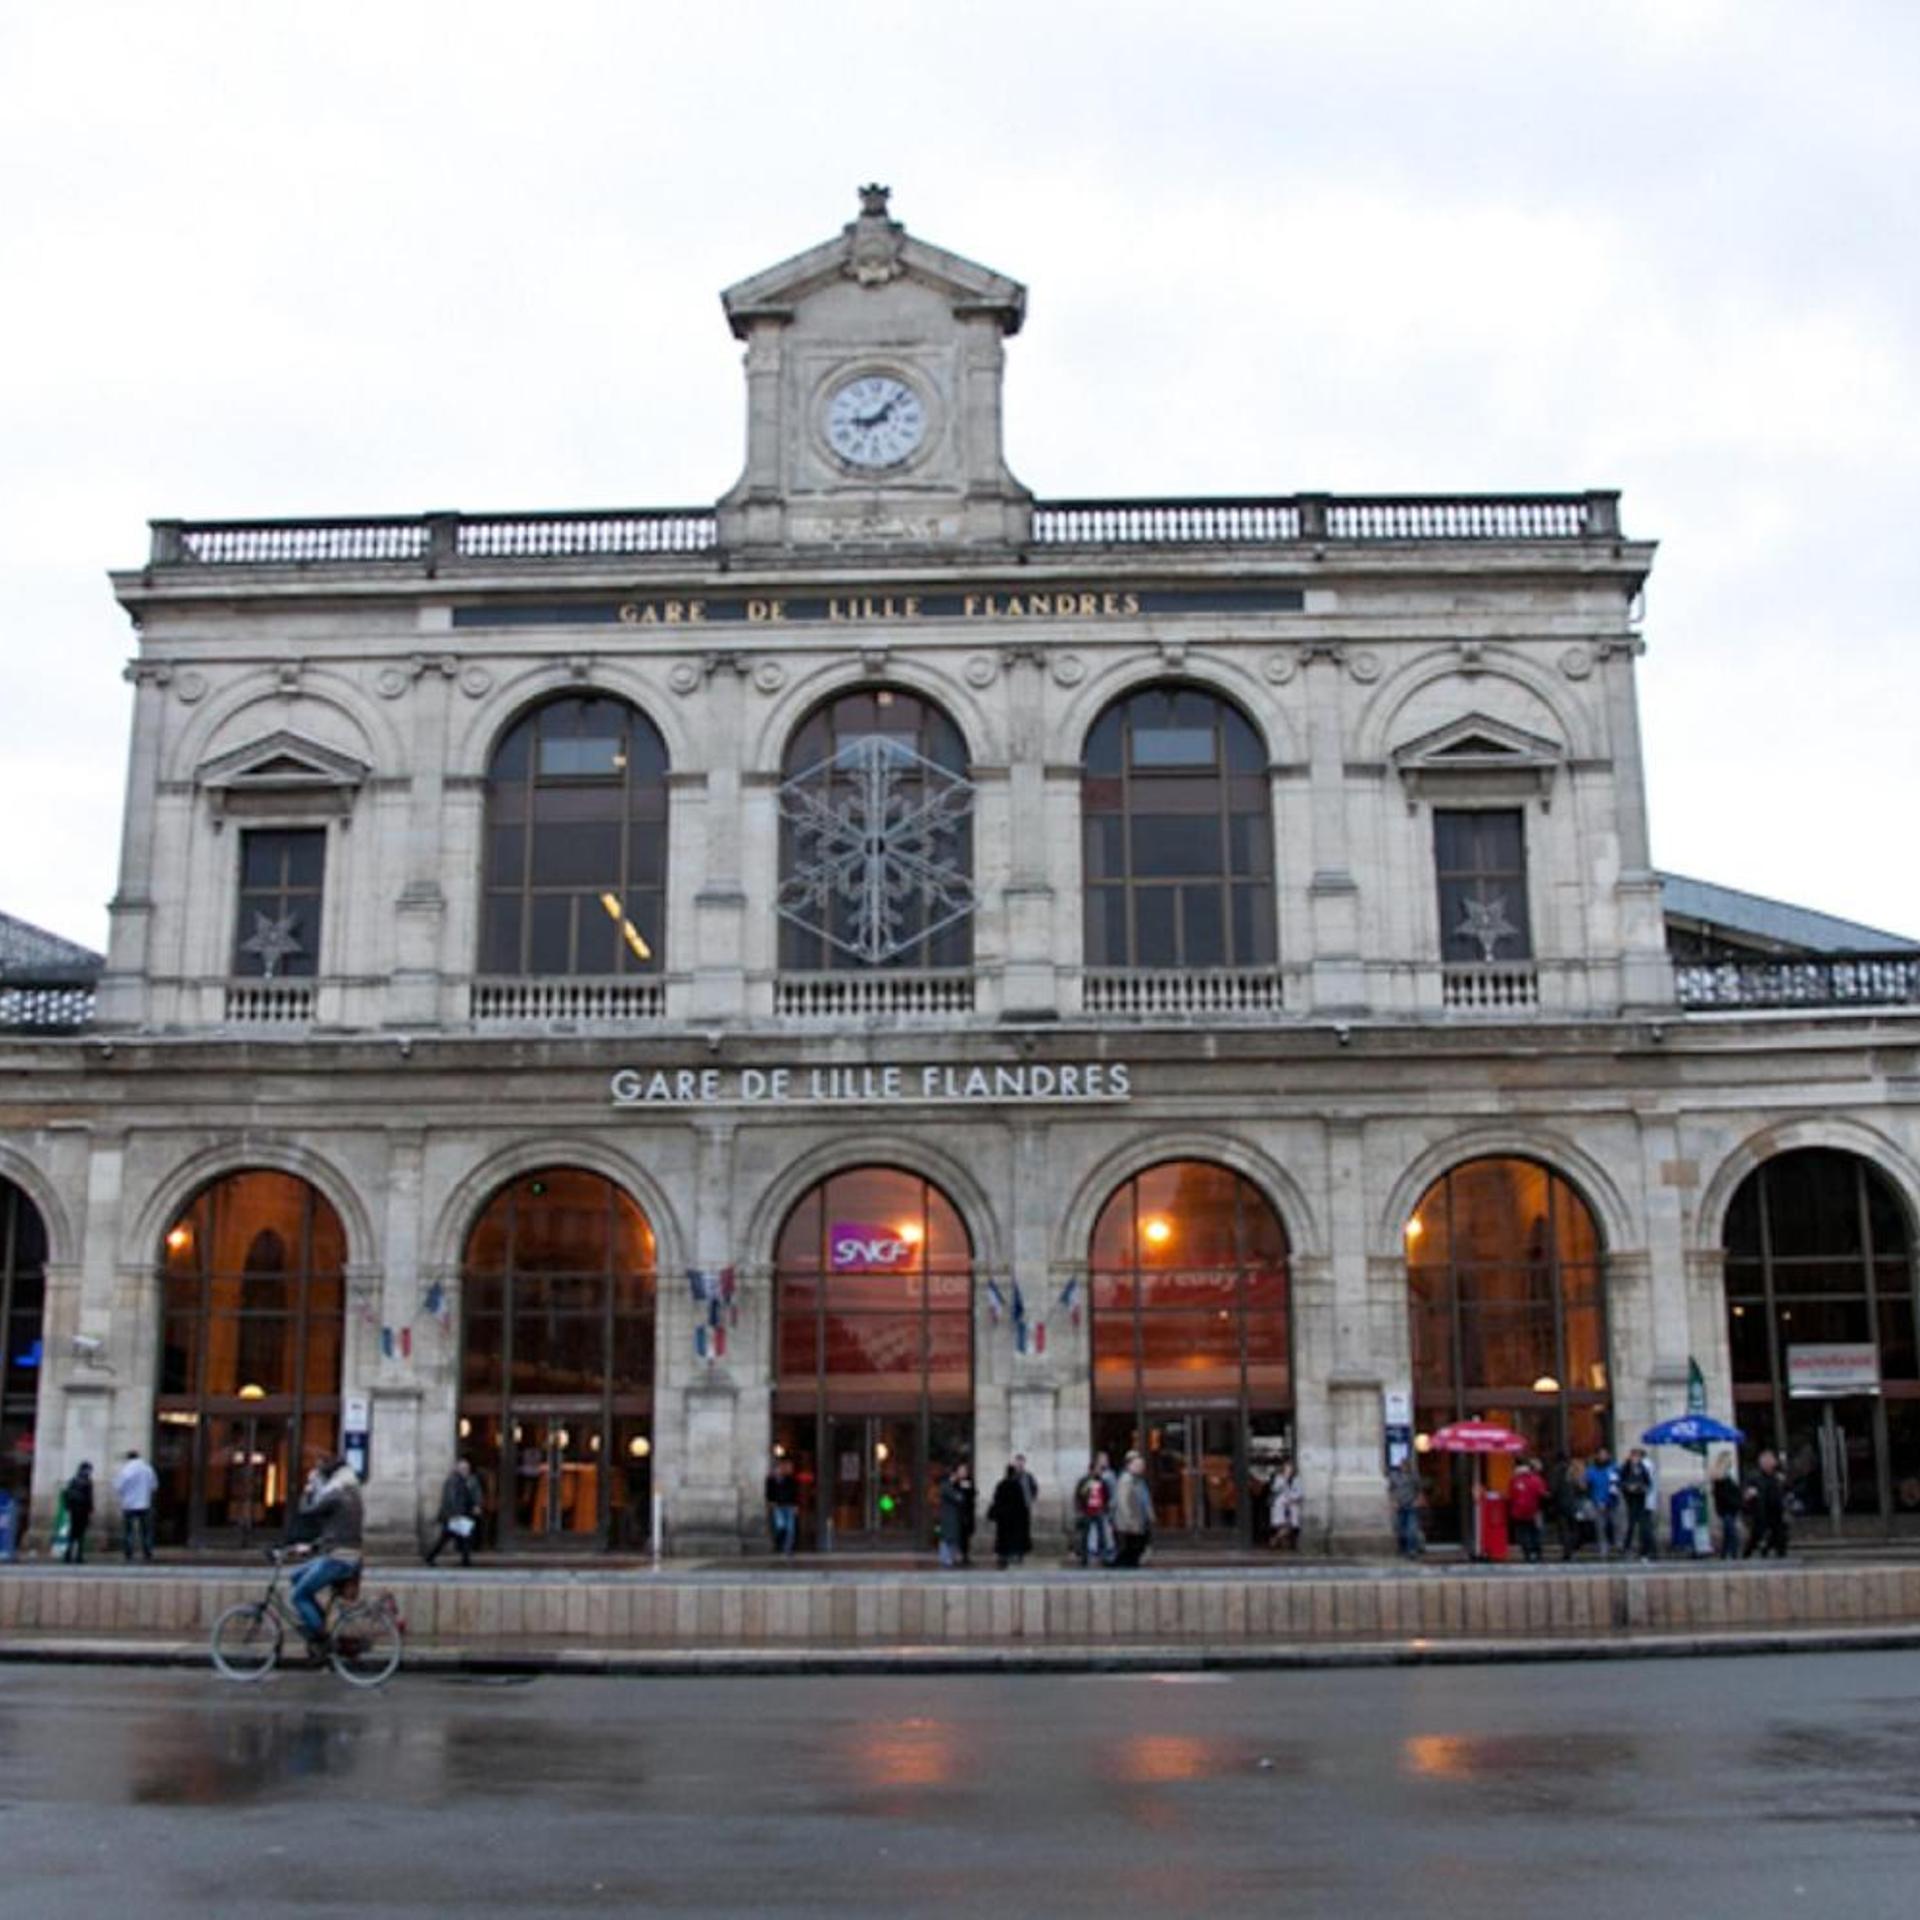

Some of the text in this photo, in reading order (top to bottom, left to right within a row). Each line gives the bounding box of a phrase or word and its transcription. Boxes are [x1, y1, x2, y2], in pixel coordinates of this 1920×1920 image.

[619, 593, 1140, 623] GARE DE LILLE FLANDRES
[610, 1063, 1131, 1100] GARE DE LILLE FLANDRES
[833, 1238, 909, 1264] SNCF
